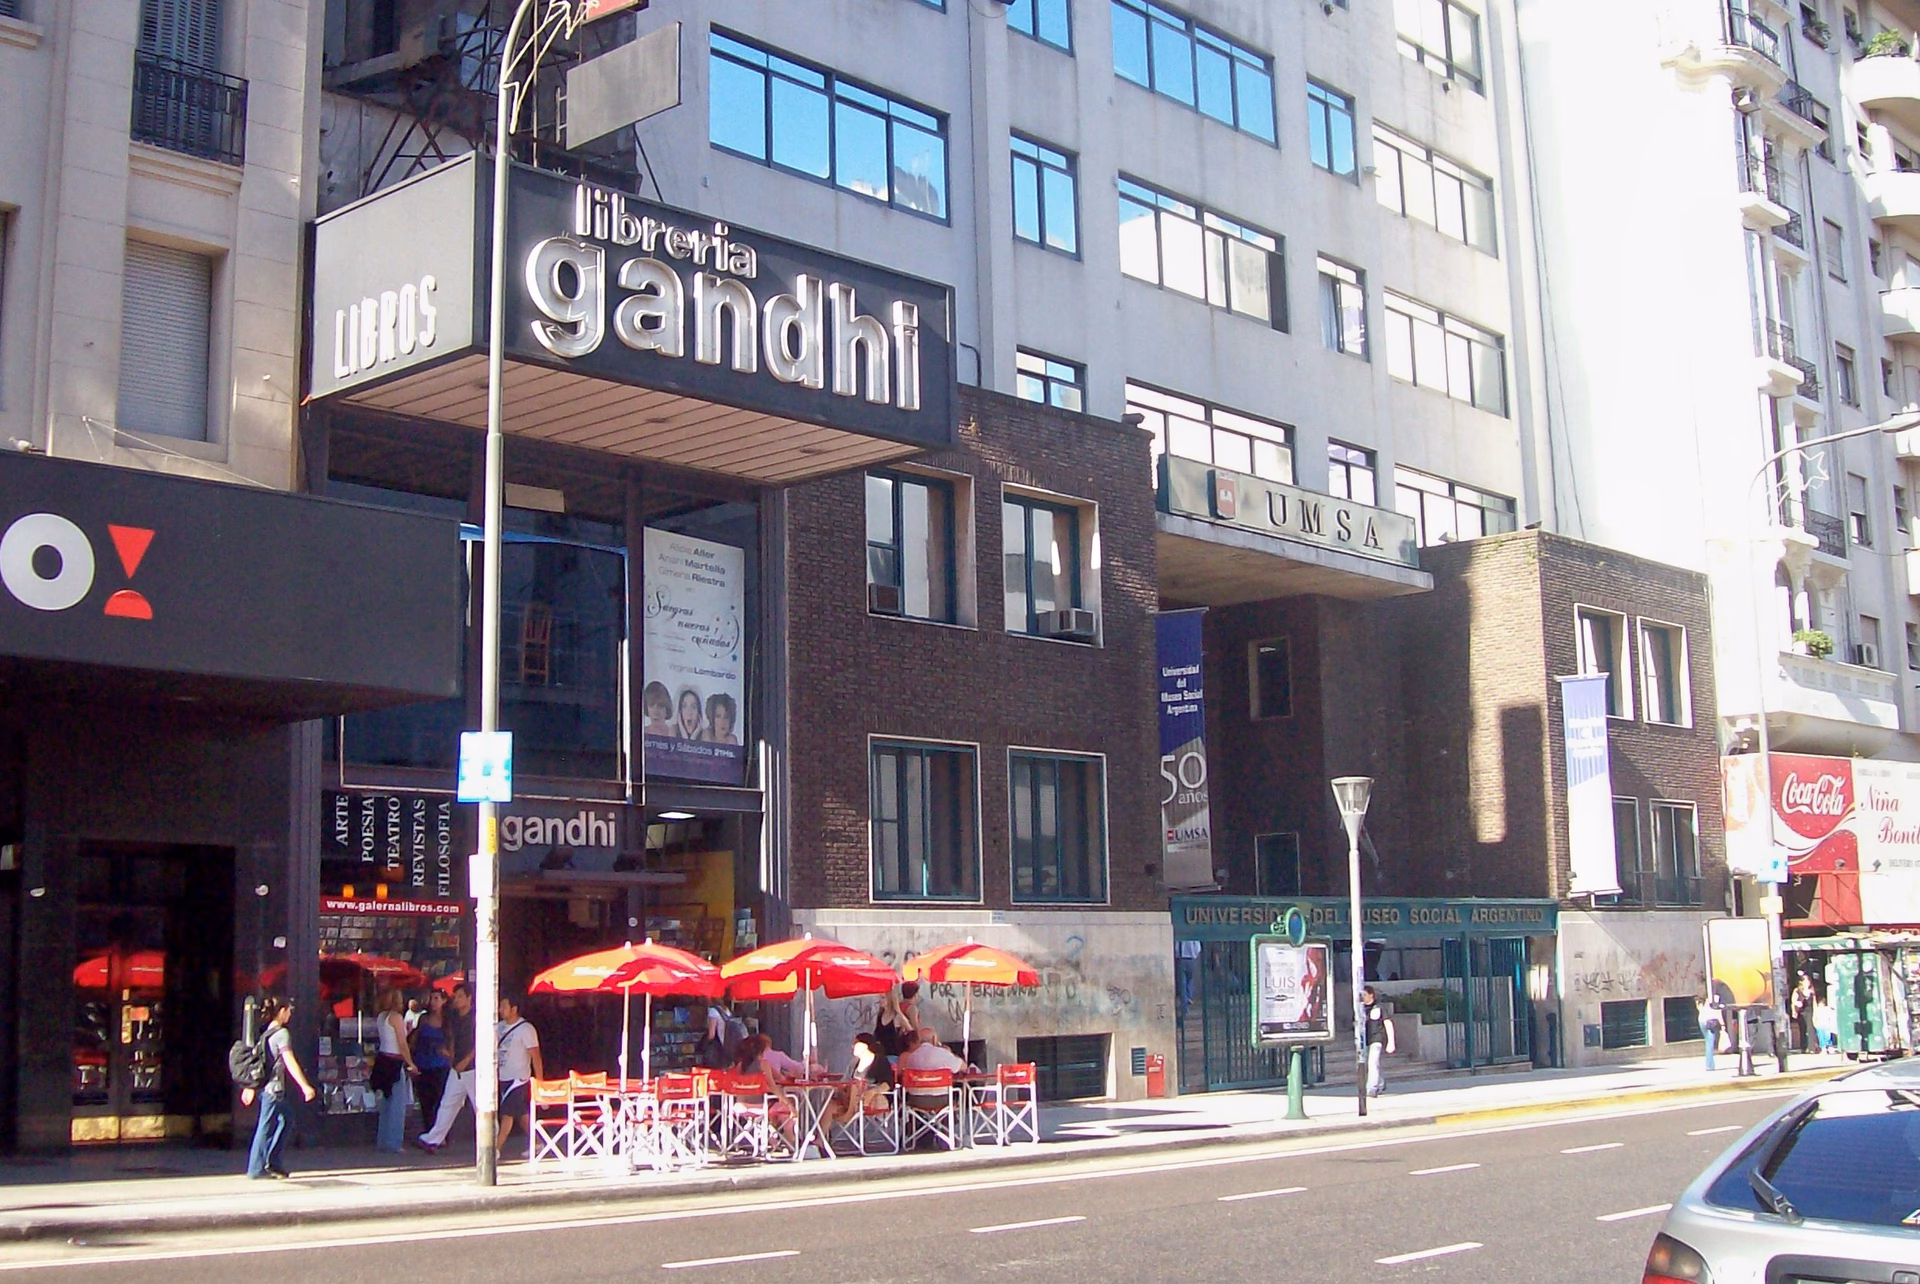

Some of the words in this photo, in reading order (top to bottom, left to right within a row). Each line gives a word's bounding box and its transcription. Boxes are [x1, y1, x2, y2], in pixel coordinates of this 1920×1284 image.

[575, 183, 758, 279] libreria
[333, 274, 438, 380] LIBROS
[525, 236, 920, 411] gandhi
[1265, 490, 1384, 550] UMSA
[694, 666, 737, 680] Lombardo
[1162, 664, 1200, 678] Universidad
[1176, 677, 1187, 688] del
[1183, 688, 1204, 701] Social
[1160, 751, 1208, 805] 50
[1178, 788, 1209, 804] años
[1782, 772, 1845, 815] Coca-Cola
[1861, 785, 1899, 811] Niña
[334, 795, 349, 847] ARTE
[361, 796, 375, 863] POESIA
[387, 796, 401, 872] TEATRO
[502, 810, 616, 851] gandhi
[1175, 827, 1209, 841] UMSA
[412, 799, 426, 888] REVISTAS
[438, 801, 451, 897] FILOSOFIA
[326, 900, 460, 914] www.galernalibros.com
[1313, 908, 1343, 924] DEL
[1410, 907, 1462, 925] SOCIAL
[1471, 907, 1545, 923] ARGENTINO
[1264, 976, 1296, 989] LUIS
